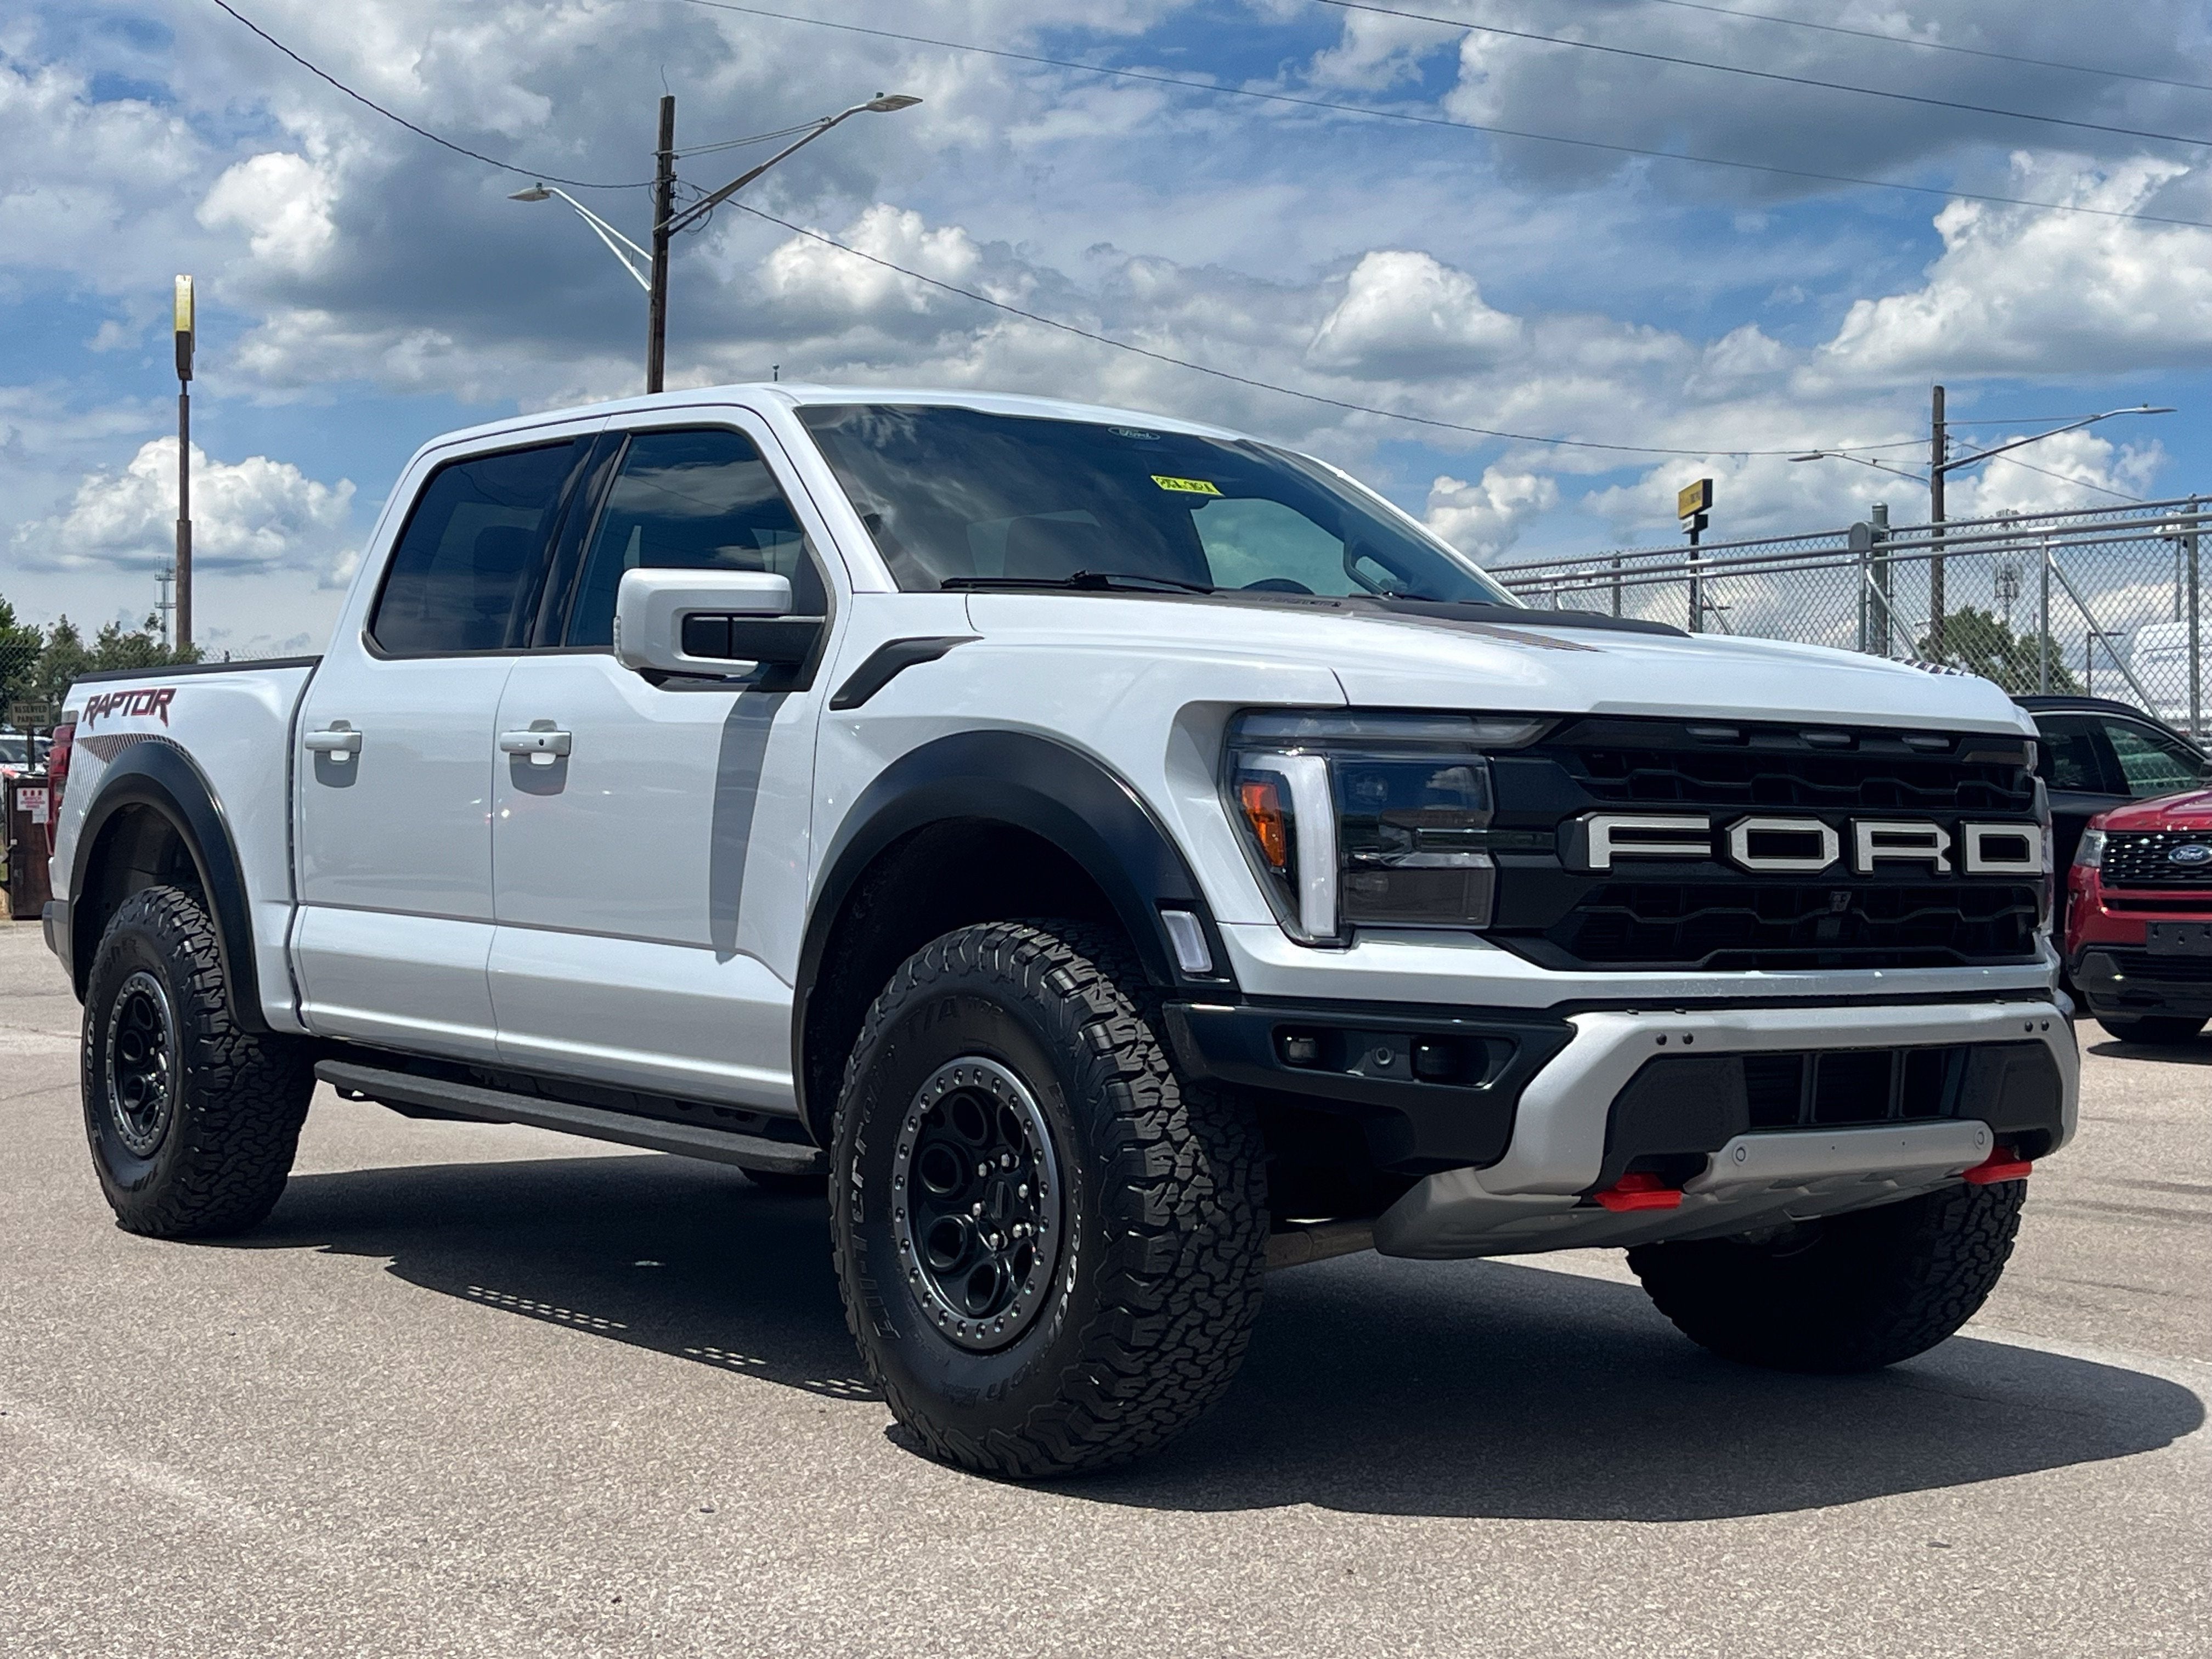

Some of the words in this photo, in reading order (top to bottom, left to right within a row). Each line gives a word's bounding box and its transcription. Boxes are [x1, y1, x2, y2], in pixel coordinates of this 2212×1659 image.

[14, 705, 47, 713] RESERVED
[82, 689, 177, 731] RAPTOR
[1587, 814, 2042, 873] FORD
[2176, 848, 2203, 860] Ford
